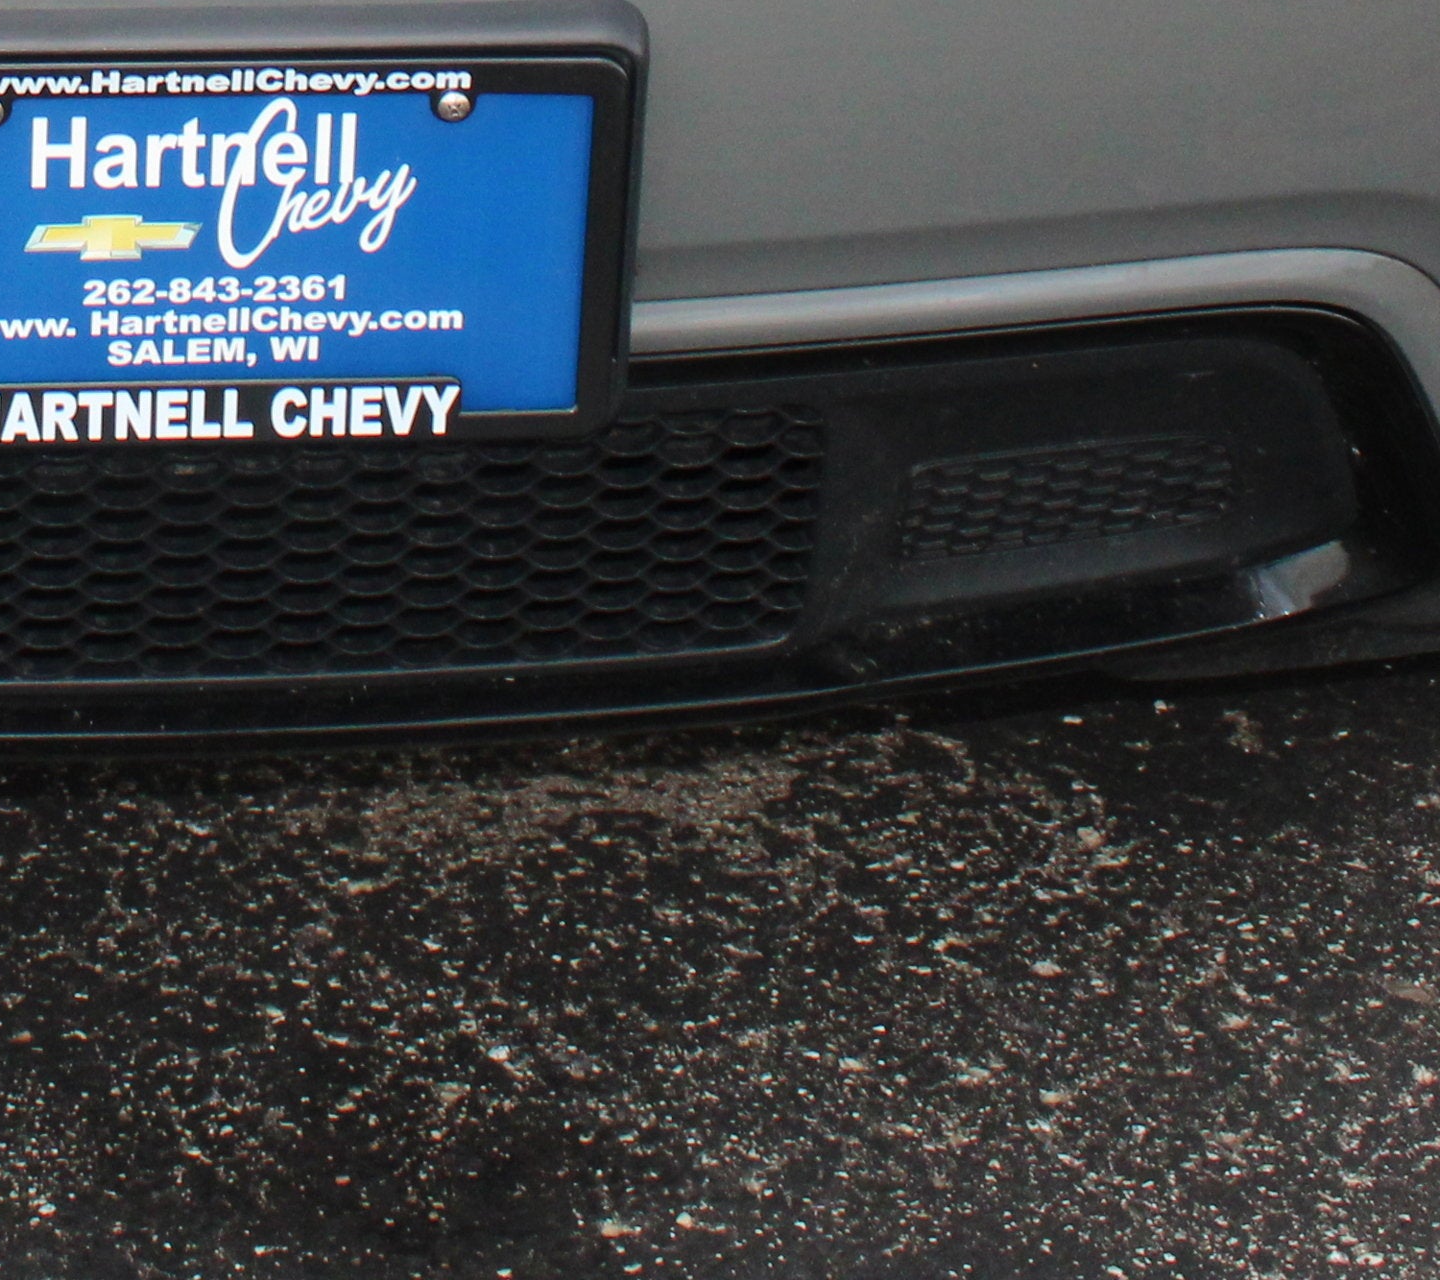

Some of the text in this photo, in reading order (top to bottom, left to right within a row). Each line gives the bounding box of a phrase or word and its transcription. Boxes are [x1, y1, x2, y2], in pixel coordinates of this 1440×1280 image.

[29, 112, 358, 190] Hartnell
[217, 96, 417, 269] Chevy
[82, 275, 347, 306] 262-843-2361
[90, 306, 464, 337] HartnellChevy.com
[107, 334, 320, 367] SALEM, WI
[271, 385, 461, 438] CHEVY
